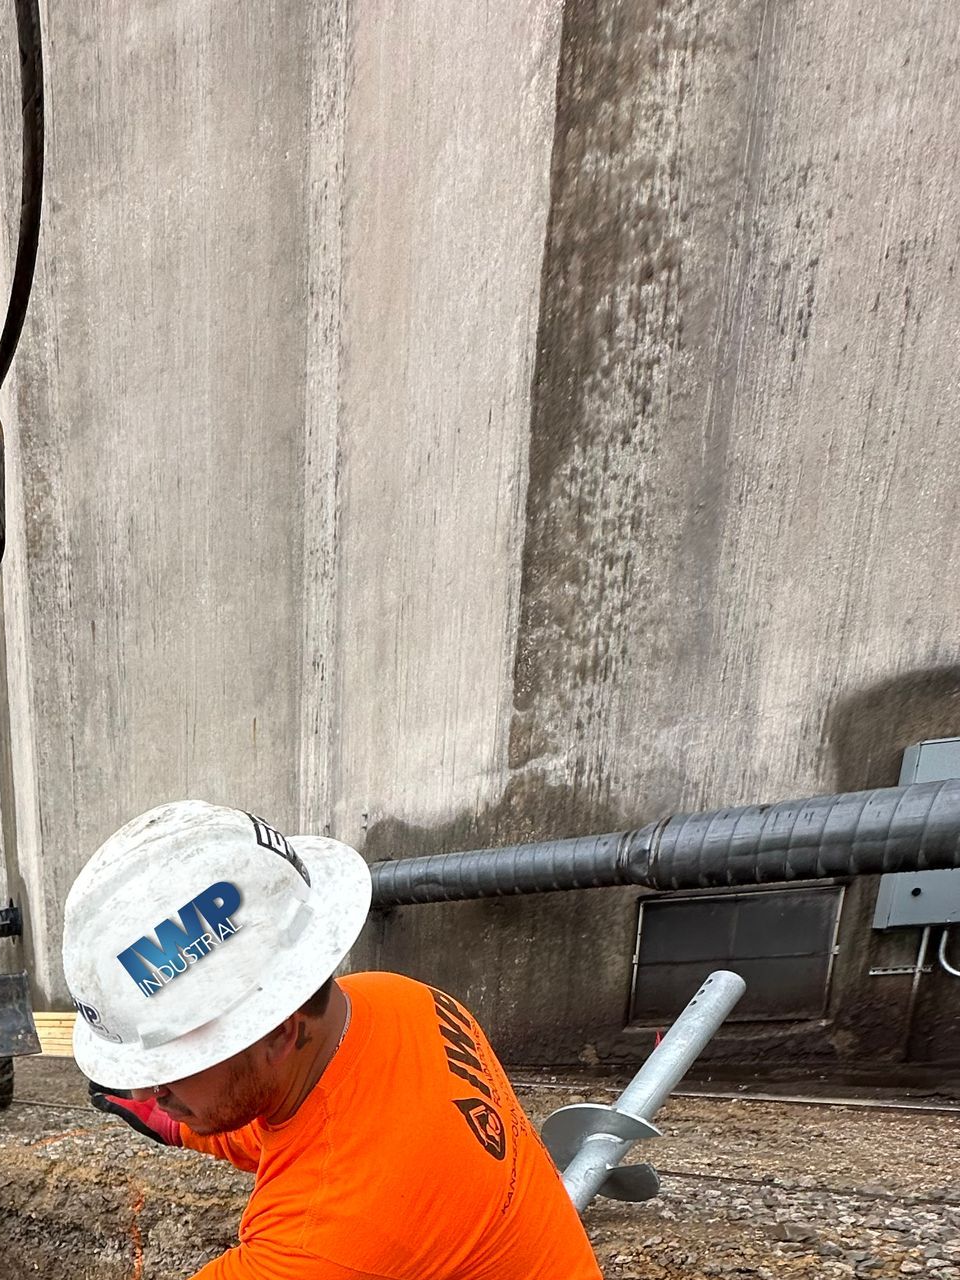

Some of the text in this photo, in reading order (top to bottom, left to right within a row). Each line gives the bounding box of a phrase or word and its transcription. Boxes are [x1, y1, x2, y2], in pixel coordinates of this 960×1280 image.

[116, 881, 242, 998] IWP
[138, 917, 244, 998] INDUSTRIAL
[427, 986, 493, 1100] IWP
